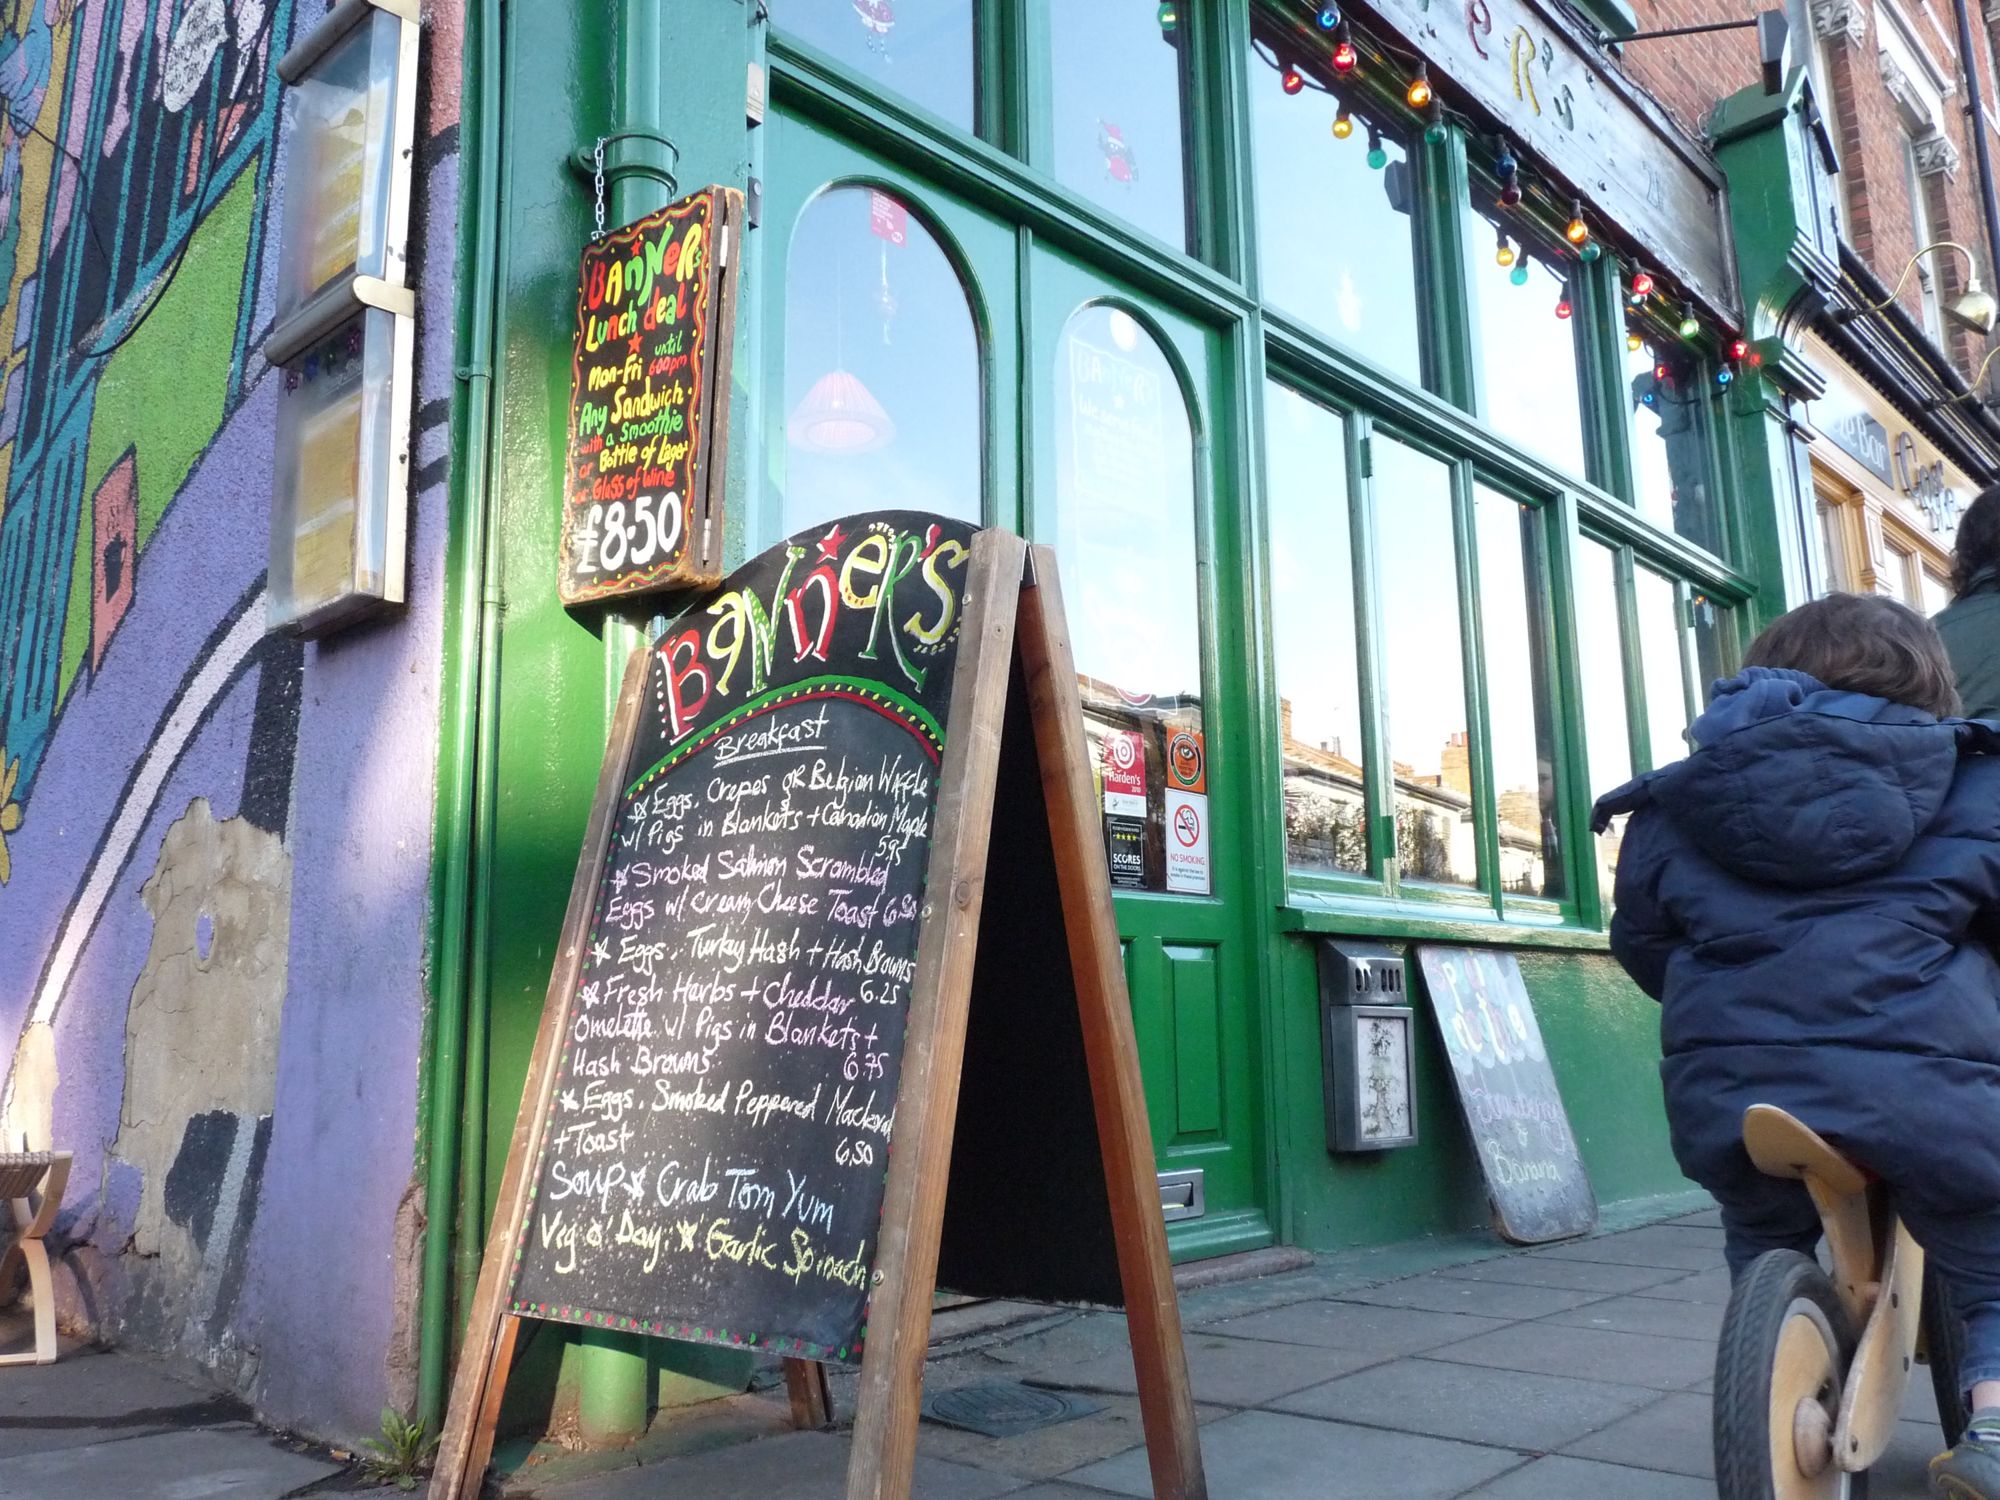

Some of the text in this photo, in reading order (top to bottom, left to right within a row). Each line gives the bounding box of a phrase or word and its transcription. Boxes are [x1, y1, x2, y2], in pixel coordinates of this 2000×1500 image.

[585, 282, 687, 352] Lunch deal
[654, 330, 683, 356] until
[588, 352, 643, 392] Mon-Fri
[579, 375, 684, 437] Any Sandwich
[580, 404, 684, 454] with a Smoothie
[578, 434, 689, 479] or Bottle of Lager
[1856, 415, 1887, 472] Bar
[575, 488, 590, 505] or
[625, 466, 643, 500] of
[642, 466, 676, 488] Wine
[572, 490, 682, 573] £8.50
[713, 703, 829, 761] Breakfast
[707, 775, 770, 812] Crepes
[809, 755, 874, 809] Belgian
[648, 820, 684, 854] Pigs
[698, 815, 713, 837] in
[721, 800, 803, 837] Blankets
[821, 800, 888, 831] Canadian
[888, 801, 928, 849] Maple
[632, 843, 891, 895] Smoked Salmon Scrambled
[1113, 852, 1141, 865] SCORES
[1170, 853, 1205, 866] NO SMOKING
[605, 895, 655, 930] Eggs
[690, 890, 752, 925] Cream
[757, 878, 818, 915] Cheese
[828, 889, 879, 928] Toast
[747, 927, 801, 966] Hash
[807, 938, 823, 967] +
[821, 933, 866, 974] Hash
[863, 940, 916, 984] Browns
[603, 973, 664, 1006] Fresh
[740, 976, 761, 1003] +
[763, 971, 855, 1015] Cheddar
[860, 979, 900, 1005] 6.25
[574, 1003, 652, 1042] Omelette
[696, 1006, 732, 1055] Pigs
[739, 1012, 756, 1040] in
[765, 1010, 861, 1051] Blankets
[864, 1023, 879, 1050] +
[573, 1046, 711, 1078] Hash Browns
[843, 1051, 890, 1082] 6.75
[651, 1077, 730, 1115] Smoked
[734, 1079, 822, 1127] Peppered
[568, 1120, 634, 1157] Toast
[835, 1137, 873, 1167] 6.50
[1487, 1138, 1563, 1184] Banana
[656, 1157, 719, 1207] Crab
[725, 1168, 775, 1219] Tom
[782, 1169, 834, 1235] Yum
[542, 1209, 578, 1274] Veg
[706, 1217, 777, 1270] Garlic
[783, 1226, 868, 1290] Spinach
